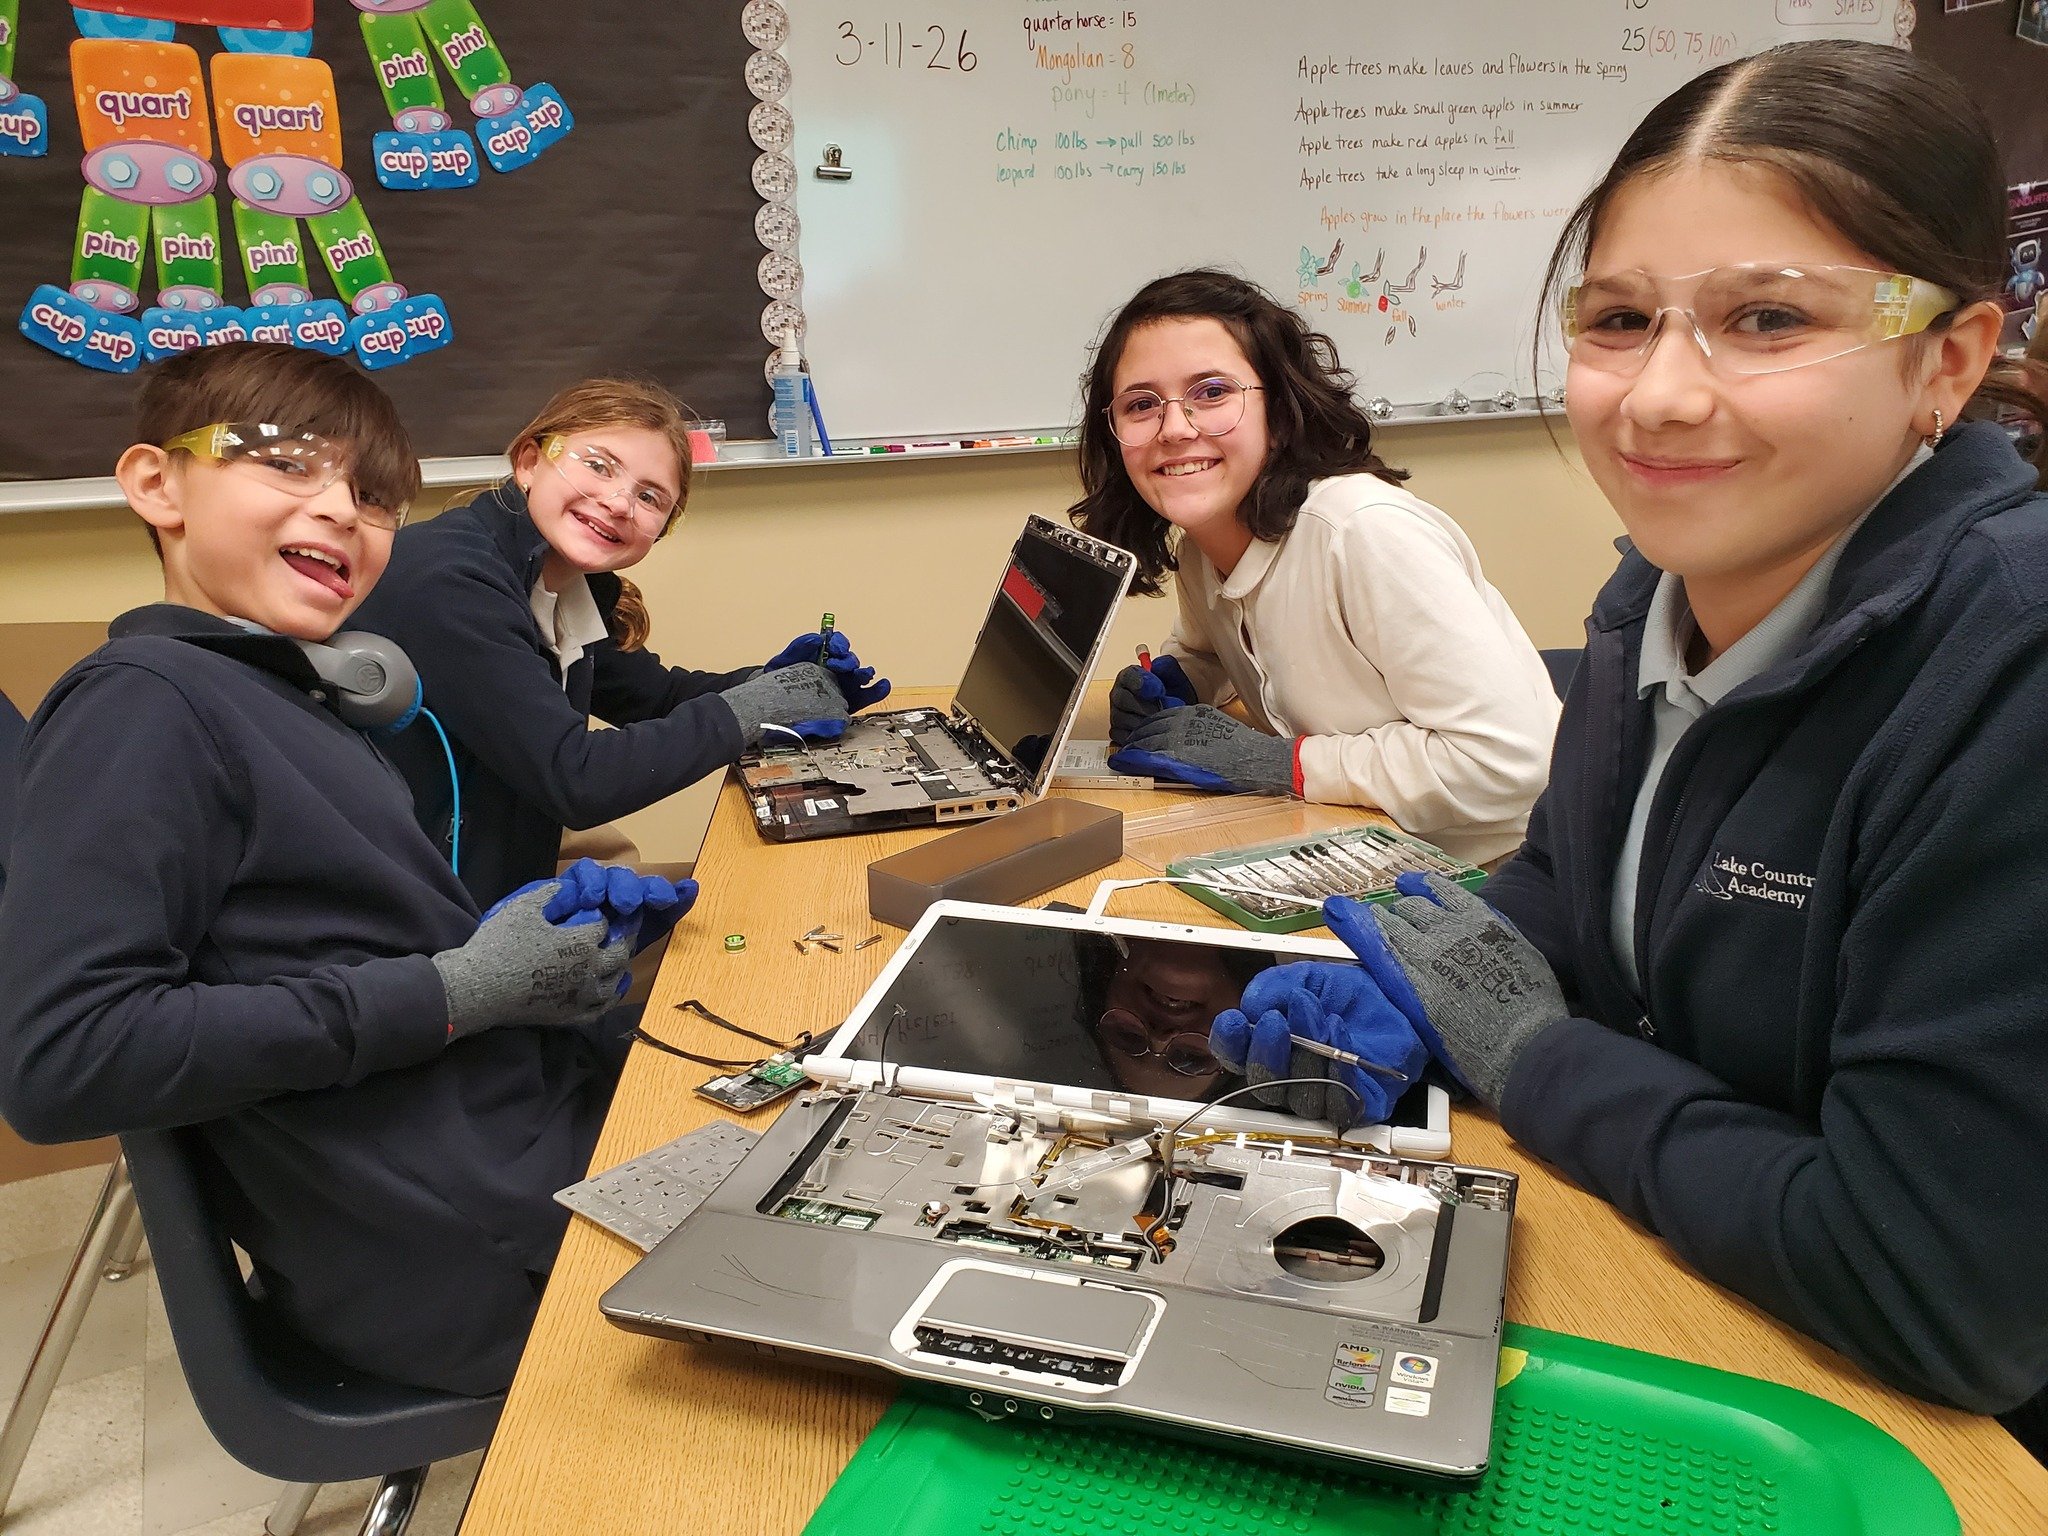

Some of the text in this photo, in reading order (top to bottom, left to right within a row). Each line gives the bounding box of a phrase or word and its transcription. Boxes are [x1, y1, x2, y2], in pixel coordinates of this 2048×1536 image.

[1122, 10, 1137, 29] 15
[444, 27, 485, 67] pint
[835, 20, 978, 72] 3-11-26
[1621, 26, 1646, 52] 25
[381, 54, 426, 86] pint
[1035, 42, 1105, 86] Mongolian
[1121, 42, 1135, 70] 8
[1298, 55, 1340, 84] Apple
[1345, 55, 1383, 76] trees
[1388, 57, 1428, 76] make
[1434, 57, 1474, 76] leaves
[1482, 58, 1504, 75] and
[1509, 52, 1556, 75] flowers
[1574, 57, 1592, 75] the
[98, 92, 191, 123] quart
[1051, 85, 1097, 119] pony
[1117, 80, 1130, 105] 4
[1293, 96, 1330, 125] Apple
[1331, 99, 1367, 120] trees
[1374, 100, 1408, 118] make
[1413, 100, 1445, 116] small
[1447, 103, 1478, 125] green
[1481, 97, 1515, 120] apples
[1522, 99, 1534, 111] in
[0, 116, 38, 142] up
[236, 104, 323, 135] quart
[490, 127, 530, 153] cup
[1120, 130, 1143, 155] pull
[1152, 132, 1173, 148] 500
[1178, 129, 1196, 146] lbs
[1298, 135, 1332, 157] Apple
[1336, 134, 1363, 150] trees
[1372, 132, 1404, 149] make
[1407, 134, 1429, 148] red
[1434, 132, 1468, 151] apples
[1474, 133, 1488, 145] in
[383, 152, 427, 177] cup
[995, 163, 1036, 187] leopard
[1152, 161, 1168, 177] 150
[1172, 160, 1187, 175] lbs
[1299, 167, 1333, 190] Apple
[1336, 167, 1365, 183] trees
[1376, 164, 1400, 181] take
[1416, 161, 1436, 187] long
[1438, 161, 1465, 181] sleep
[1469, 165, 1479, 175] in
[1320, 206, 1356, 231] Apples
[1360, 210, 1388, 232] grow
[1395, 209, 1408, 225] in
[1467, 203, 1486, 222] the
[84, 232, 140, 260] pint
[164, 235, 213, 261] pint
[249, 243, 297, 270] pint
[329, 237, 373, 270] pint
[1392, 308, 1408, 323] fall
[1435, 297, 1467, 311] winter
[35, 307, 86, 343] cup
[299, 319, 342, 346] cup
[152, 328, 246, 350] cup up
[365, 330, 405, 355] cup
[1713, 851, 1818, 889] Lake Countr
[1727, 875, 1806, 909] Academy
[1339, 1343, 1370, 1353] AMD
